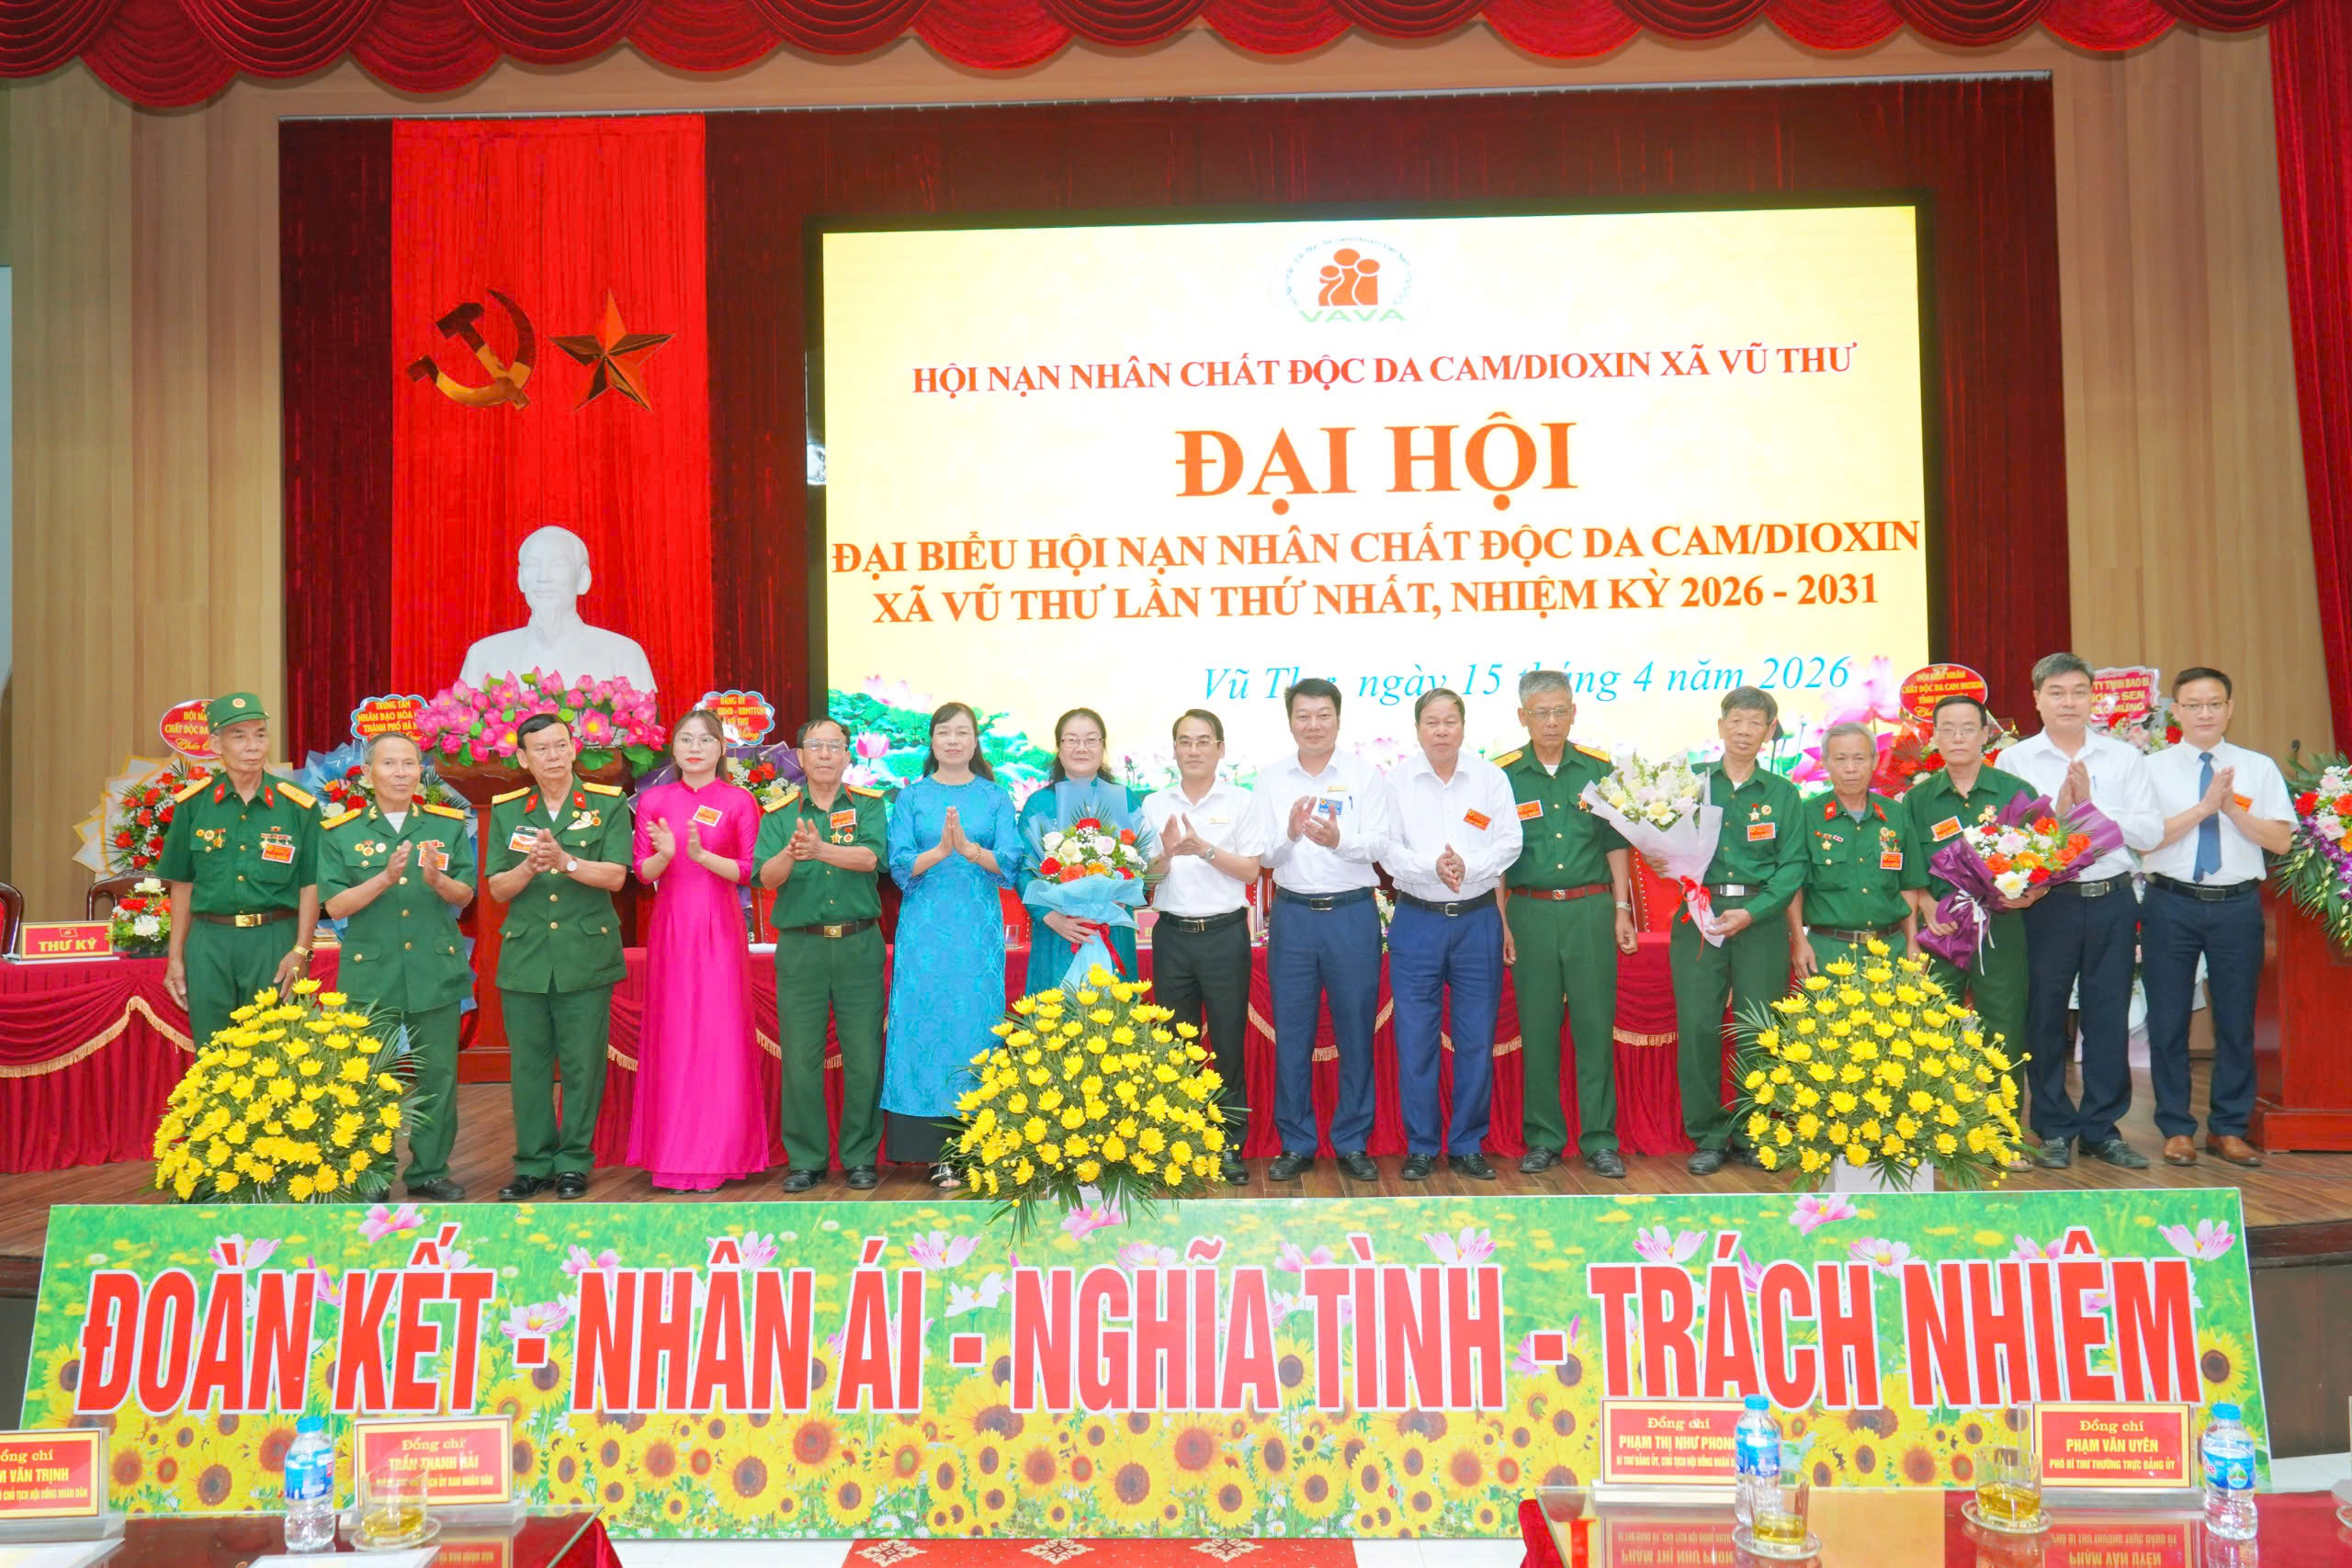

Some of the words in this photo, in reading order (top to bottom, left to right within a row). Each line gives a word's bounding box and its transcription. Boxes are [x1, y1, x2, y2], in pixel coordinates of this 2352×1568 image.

[1300, 308, 1407, 323] VAVA
[914, 363, 978, 399] HỘI
[989, 366, 1059, 397] NẠN
[1070, 355, 1170, 389] NHÂN
[1180, 353, 1279, 387] CHẤT
[1288, 355, 1365, 390] ĐỘC
[1374, 357, 1423, 382] DA
[1430, 350, 1650, 382] CAM/DIOXIN
[1660, 344, 1710, 376] XÃ
[1719, 343, 1768, 375] VŨ
[1777, 342, 1858, 373] THƯ
[1175, 427, 1357, 514] ĐẠI
[1385, 412, 1577, 511] HỘI
[831, 542, 907, 581] ĐẠI
[918, 531, 1017, 571] BIỂU
[1028, 533, 1106, 576] HỘI
[1118, 536, 1206, 575] NẠN
[1217, 525, 1338, 565] NHÂN
[1351, 523, 1470, 562] CHẤT
[1480, 524, 1572, 568] ĐỘC
[1584, 527, 1644, 558] DA
[1652, 520, 1919, 556] CAM/DIOXIN
[873, 585, 933, 622] XÃ
[942, 583, 1001, 621] VŨ
[1011, 583, 1106, 620] THƯ
[1114, 578, 1201, 618] LẦN
[1211, 576, 1306, 616] THỨ
[1316, 574, 1442, 619] NHẤT,
[1452, 575, 1597, 619] NHIỆM
[1609, 569, 1670, 609] KỲ
[1680, 575, 1764, 607] 2026
[1797, 573, 1878, 605] 2031
[1204, 668, 1250, 699] Vũ
[1462, 663, 1503, 695] 15
[1634, 660, 1655, 692] 4
[1668, 659, 1744, 692] năm
[1758, 656, 1850, 690] 2026
[2121, 690, 2145, 700] SEN
[184, 710, 197, 722] HỘI
[38, 939, 72, 952] THƯ
[75, 937, 97, 950] KÝ
[73, 1235, 316, 1416] ĐOÀN
[334, 1222, 497, 1416] KẾT
[513, 1333, 548, 1370] -
[571, 1235, 813, 1415] NHÂN
[835, 1235, 923, 1414] ÁI
[950, 1333, 985, 1368] -
[1011, 1235, 1282, 1414] NGHĨA
[1304, 1233, 1507, 1412] TÌNH
[1531, 1329, 1567, 1365] -
[1586, 1229, 1882, 1411] TRÁCH
[1647, 1416, 1685, 1430] Đồng
[1689, 1417, 1711, 1429] chí
[2080, 1418, 2118, 1433] Đồng
[2122, 1420, 2143, 1431] chí
[401, 1437, 439, 1451] Đồng
[443, 1438, 465, 1449] chí
[1619, 1435, 1652, 1451] PHẠM
[1655, 1436, 1672, 1452] THỊ
[1675, 1435, 1700, 1450] NHƯ
[2066, 1438, 2099, 1454] PHẠM
[2102, 1437, 2126, 1452] VĂN
[2129, 1437, 2158, 1452] UYÊN
[0, 1449, 28, 1463] ồng
[31, 1449, 53, 1461] chí
[420, 1454, 457, 1470] THANH
[2049, 1457, 2064, 1470] PHÓ
[2066, 1457, 2075, 1469] BÍ
[2076, 1459, 2090, 1470] THƯ
[2093, 1457, 2121, 1470] THƯỜNG
[2123, 1459, 2142, 1472] TRỰC
[2143, 1456, 2164, 1470] ĐẢNG
[2165, 1456, 2175, 1470] ỦY
[9, 1466, 32, 1483] VĂN
[36, 1467, 69, 1484] TRỊNH
